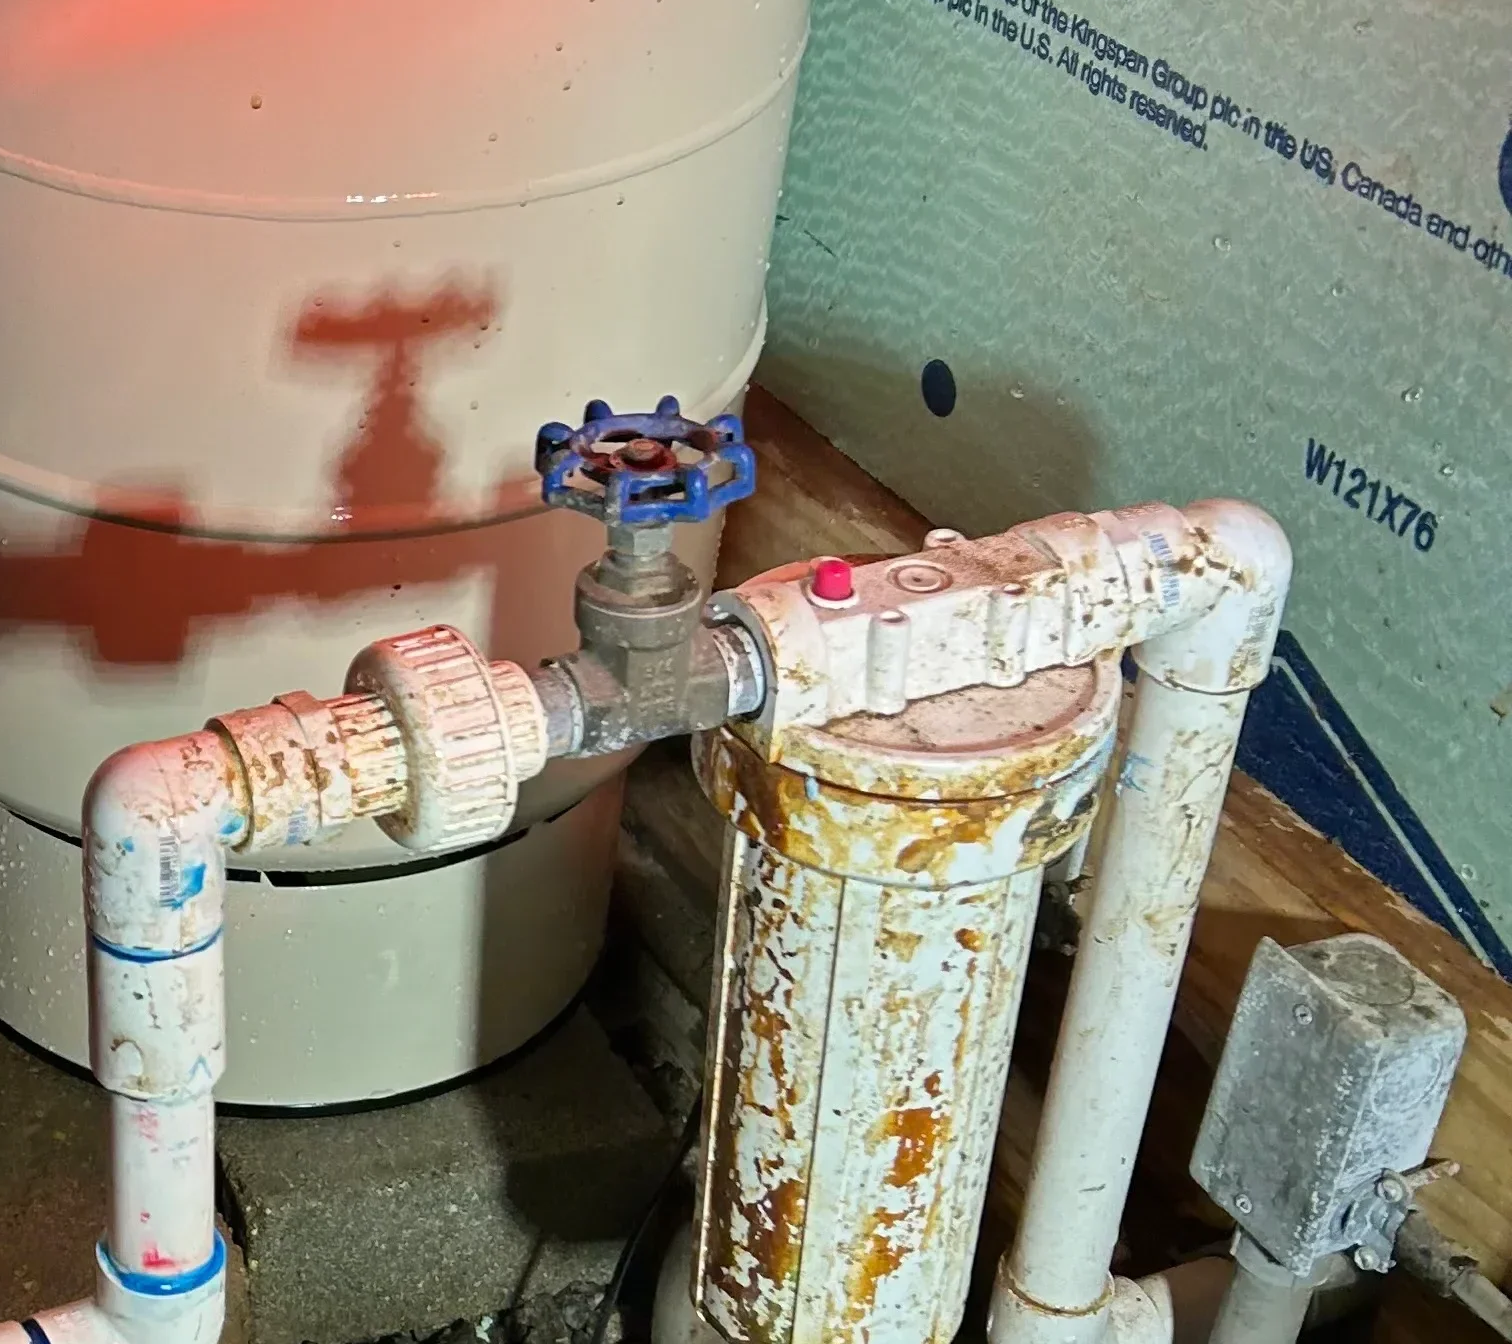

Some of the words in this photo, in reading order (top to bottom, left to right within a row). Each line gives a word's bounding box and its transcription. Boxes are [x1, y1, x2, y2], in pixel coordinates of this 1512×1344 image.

[991, 8, 1018, 42] the
[1020, 25, 1053, 64] U.S.
[1056, 45, 1078, 77] All
[1079, 60, 1127, 105] rights
[1129, 88, 1209, 152] reserved.
[1070, 13, 1148, 78] Kingspan
[1151, 57, 1208, 111] Group
[1209, 95, 1241, 129] plc
[1340, 160, 1423, 226] Canada
[1426, 212, 1471, 252] and
[1473, 238, 1512, 277] oth
[1304, 438, 1440, 552] W121X76
